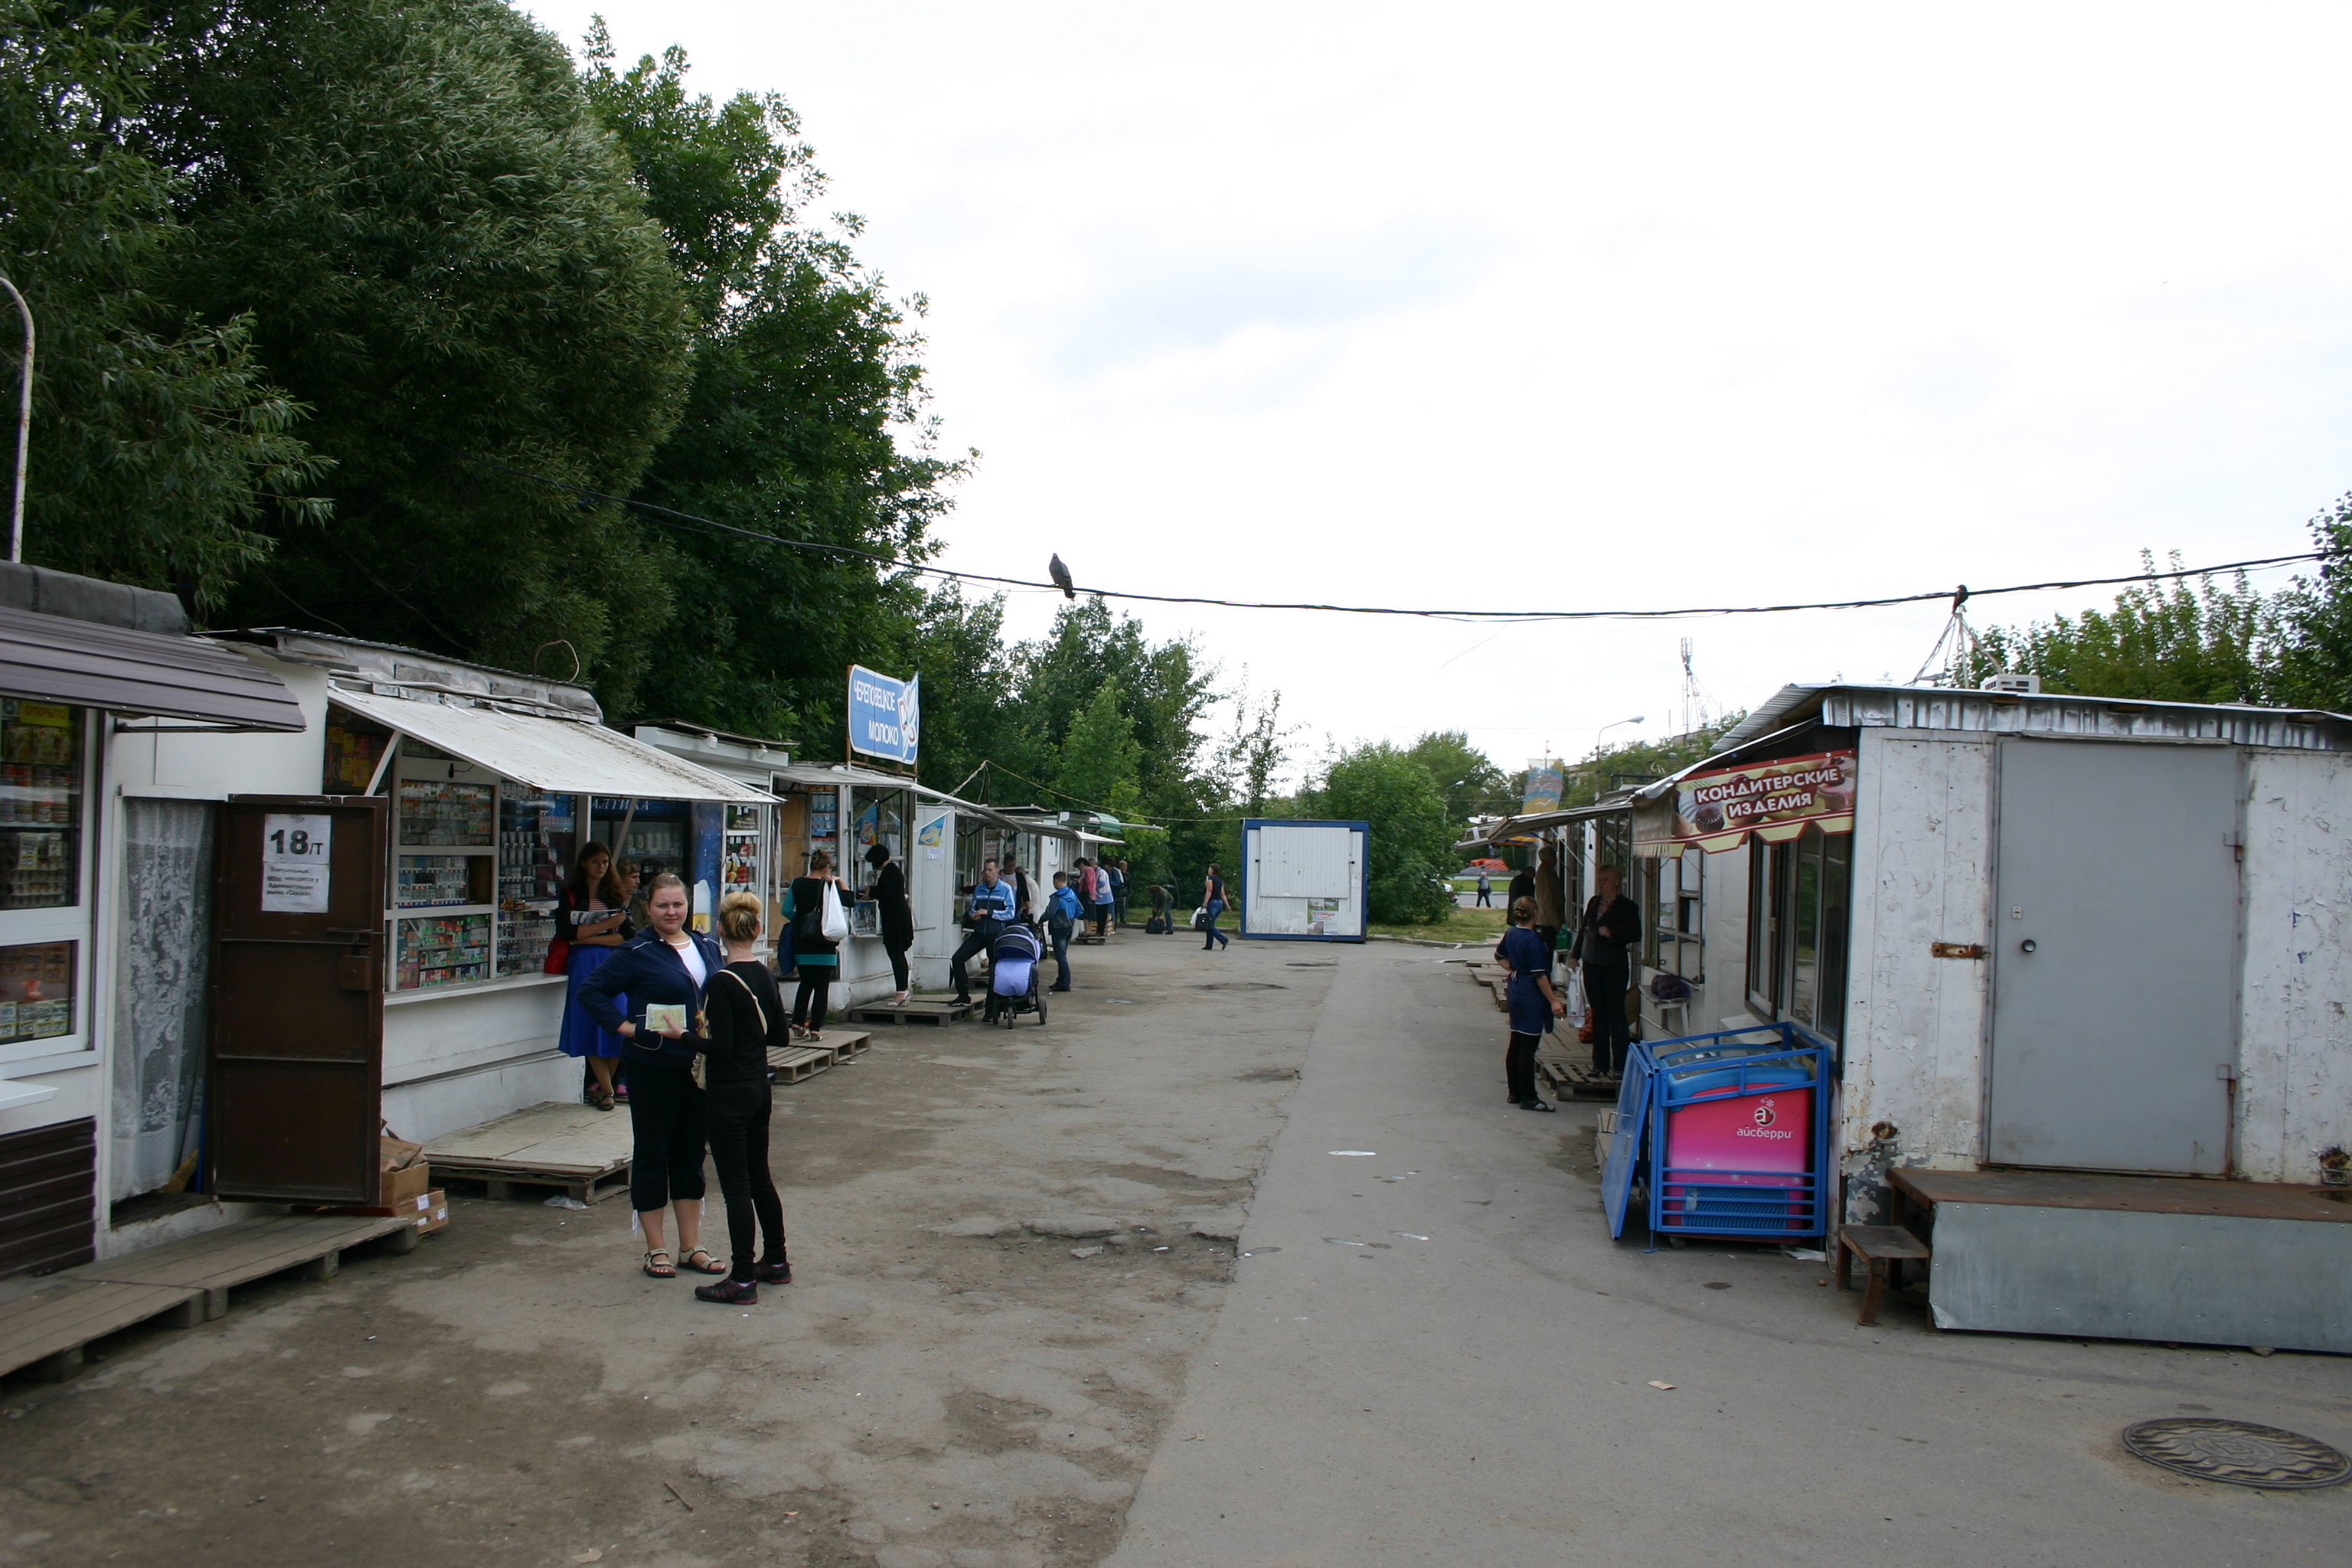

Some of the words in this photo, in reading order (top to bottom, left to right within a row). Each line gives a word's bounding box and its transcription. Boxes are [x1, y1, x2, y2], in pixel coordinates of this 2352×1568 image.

[854, 678, 896, 712] ЧЕРЕПОВЕЦКОЕ
[25, 705, 66, 720] ОТКРЫТО
[868, 720, 899, 746] МОЛОКО
[1696, 768, 1838, 803] КОНДИТЕРСКИЕ
[1728, 792, 1812, 818] ИЗДЕЛИЯ
[1736, 1126, 1792, 1140] айсберри
